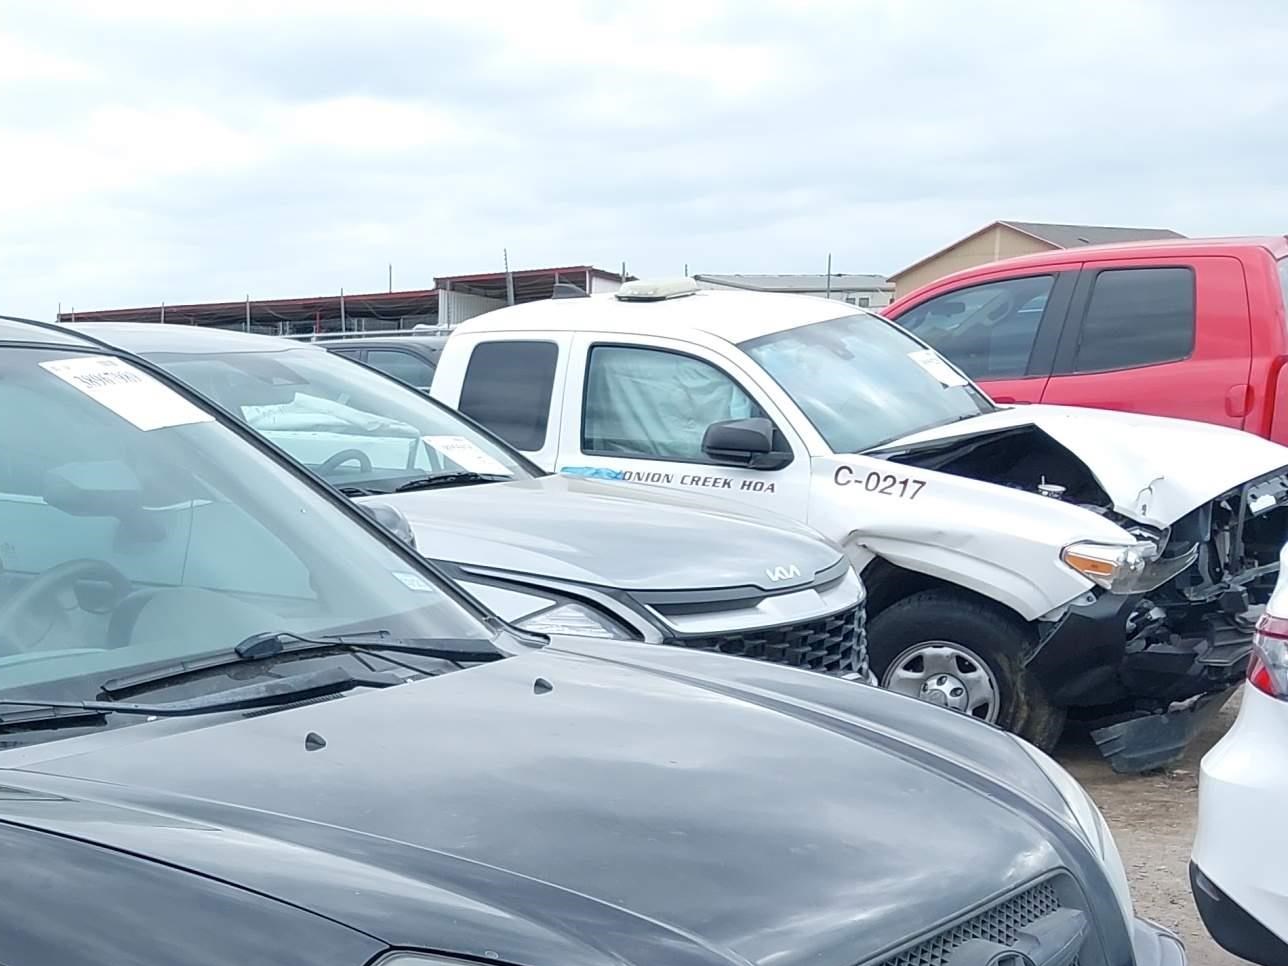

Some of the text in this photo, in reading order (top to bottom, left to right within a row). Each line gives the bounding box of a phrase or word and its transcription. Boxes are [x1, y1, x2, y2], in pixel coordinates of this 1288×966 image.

[623, 470, 776, 493] ONION CREEK HOA
[834, 465, 926, 500] C-0217
